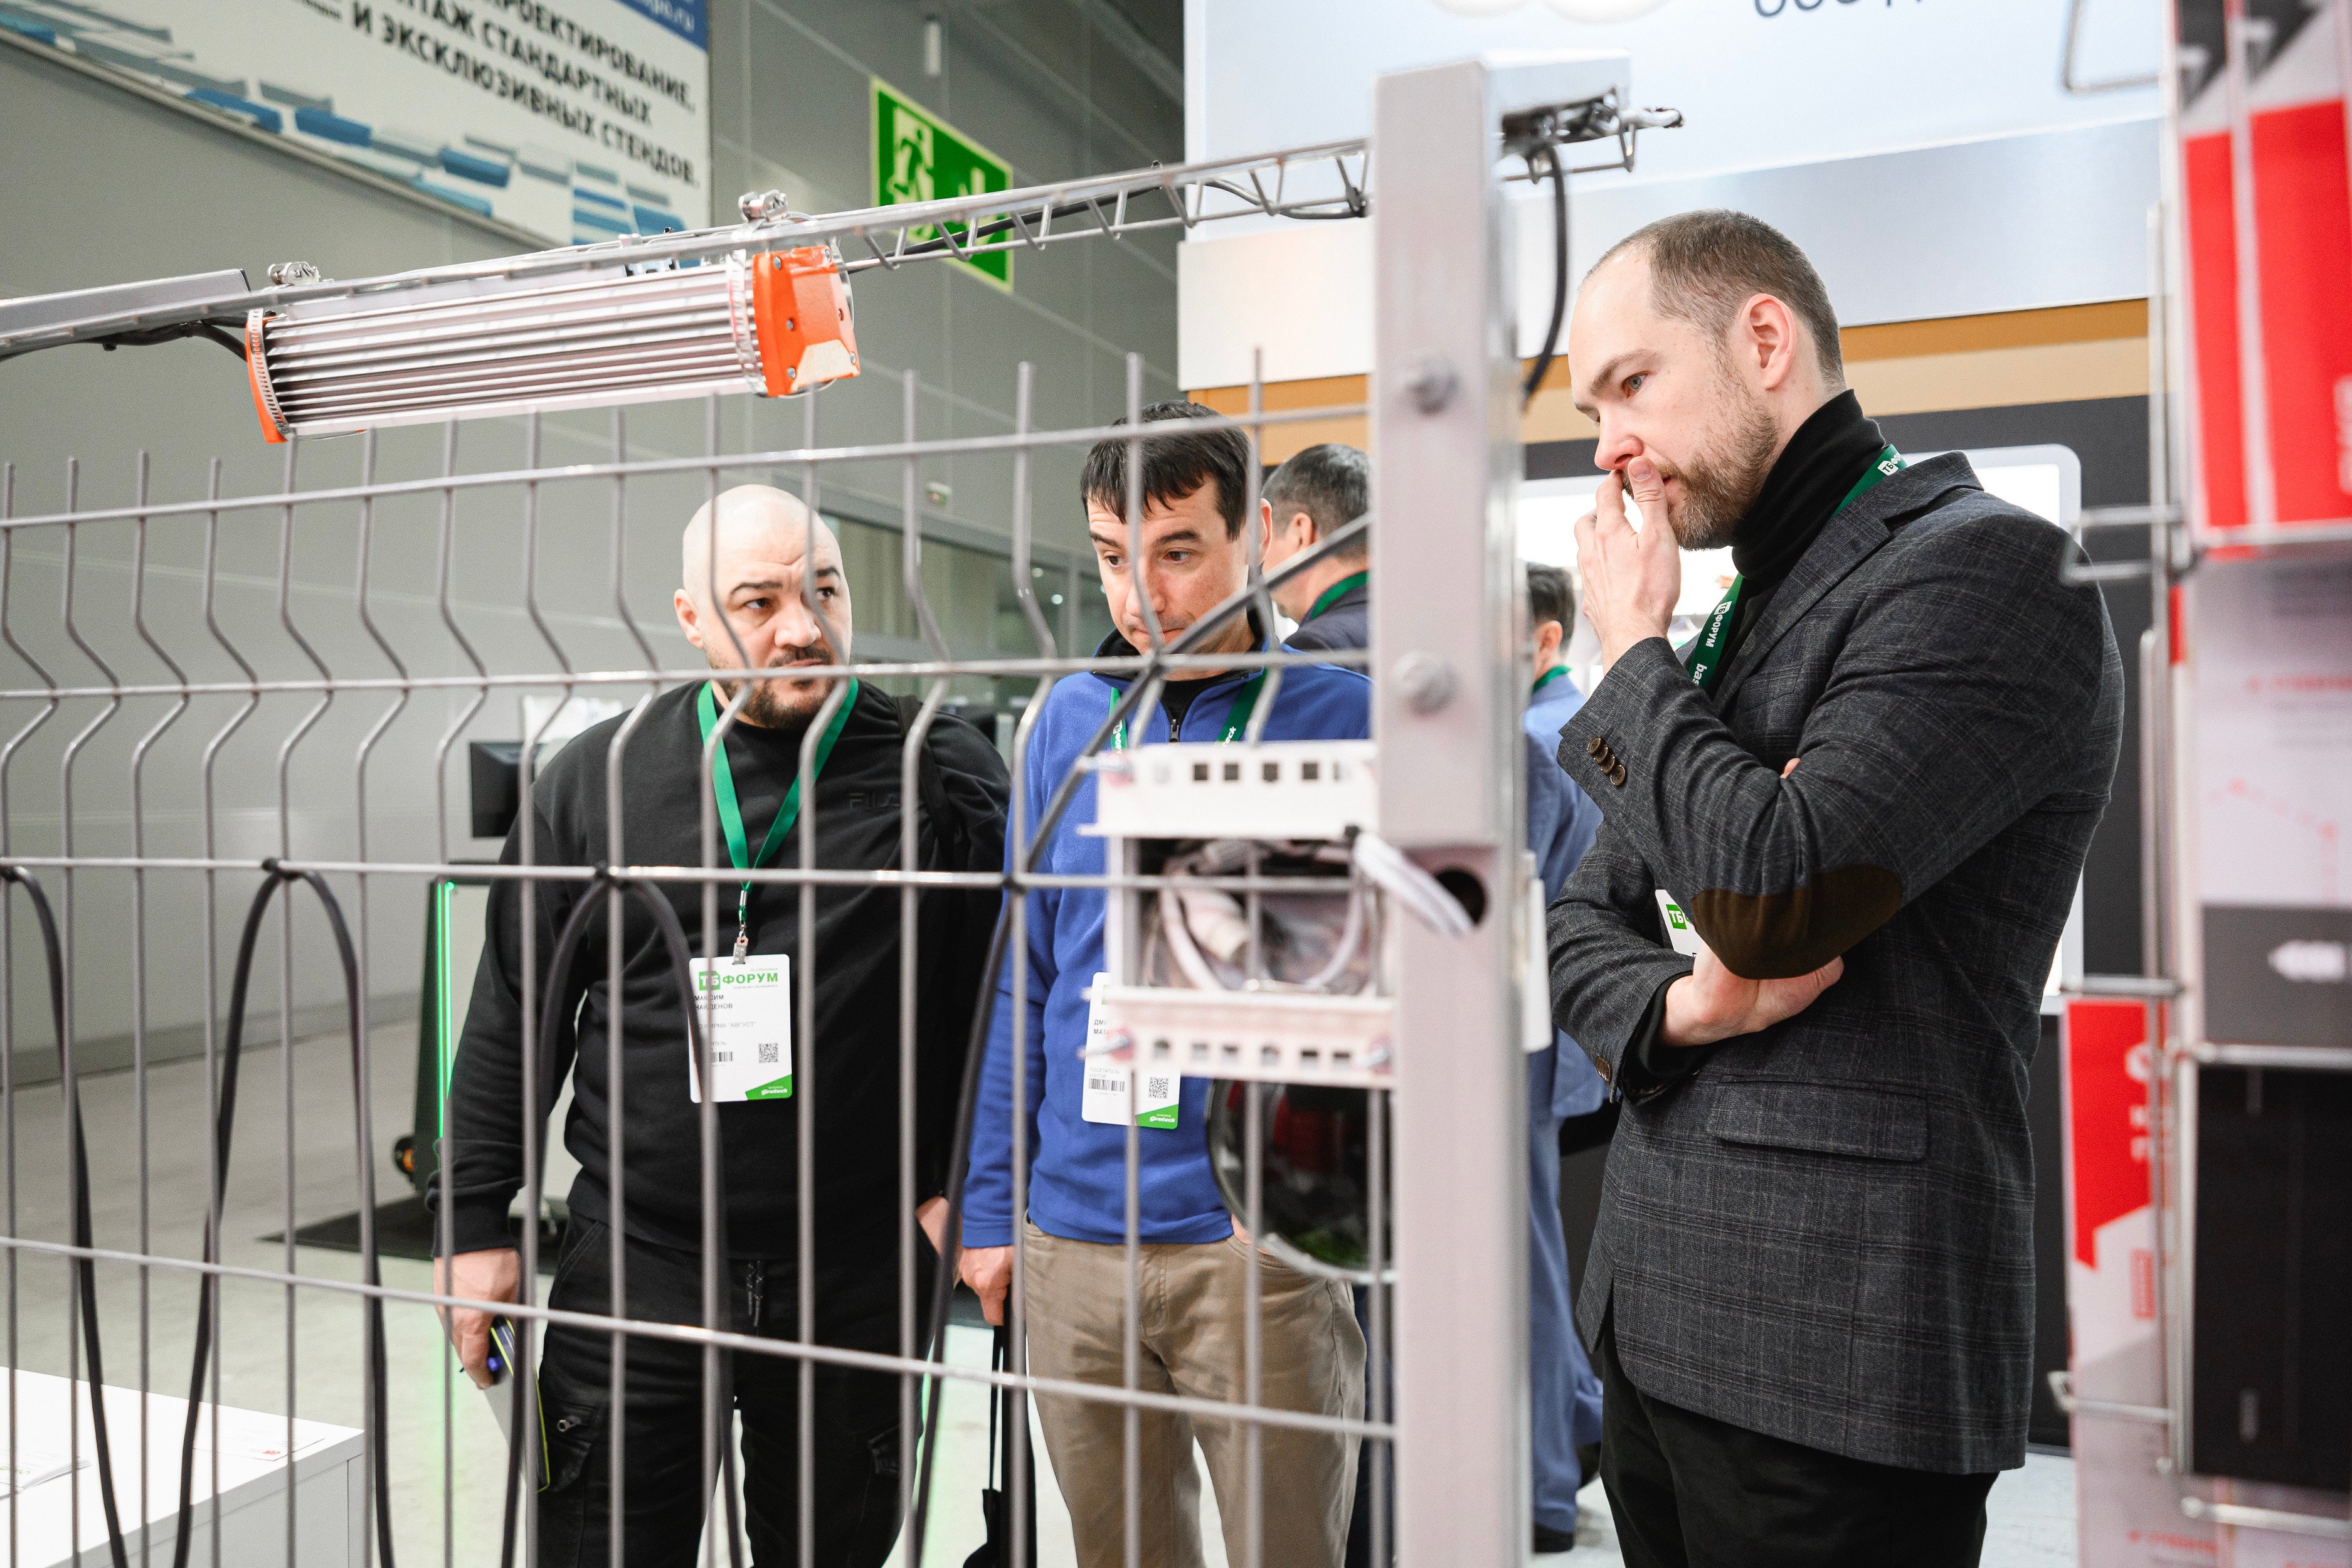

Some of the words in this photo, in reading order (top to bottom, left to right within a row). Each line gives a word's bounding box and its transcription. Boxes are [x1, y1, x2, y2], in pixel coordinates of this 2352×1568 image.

[352, 0, 371, 34] И
[381, 13, 596, 140] ЭКСКЛЮЗИВНЫХ
[481, 20, 652, 127] СТАНДАРТНЫХ
[723, 973, 778, 984] ФОРУМ
